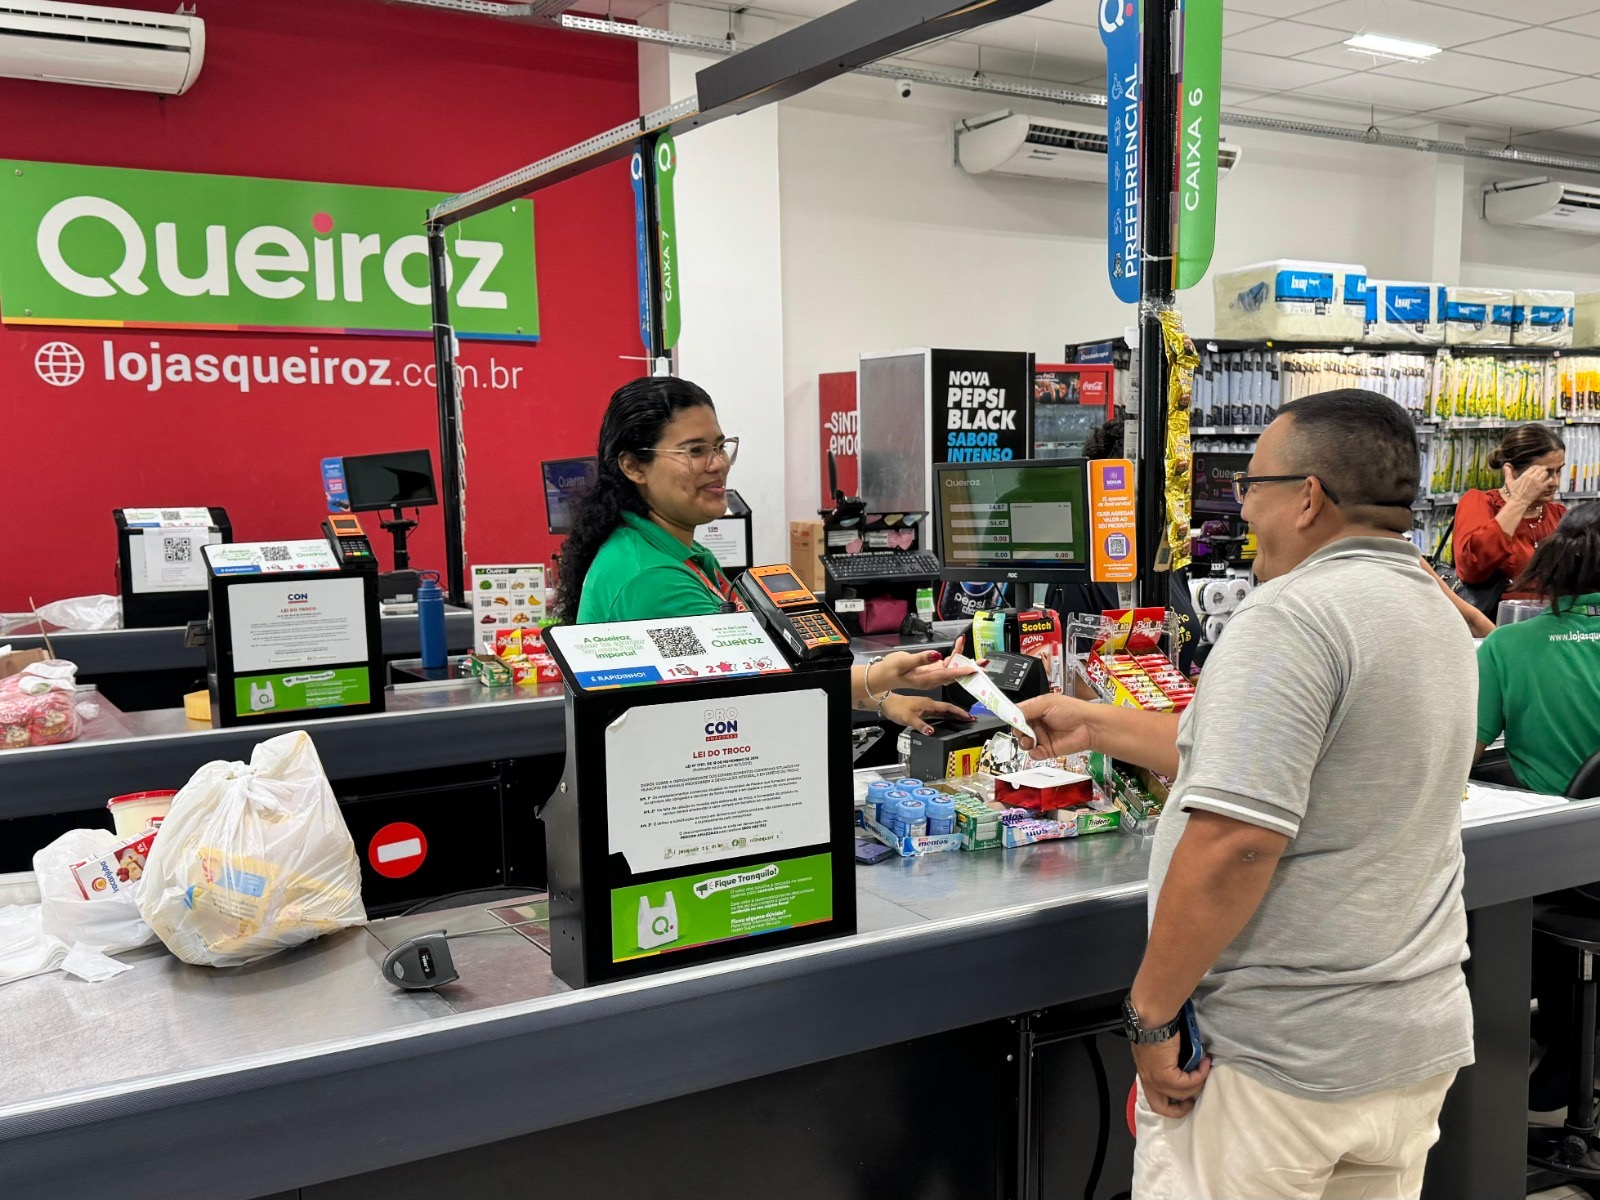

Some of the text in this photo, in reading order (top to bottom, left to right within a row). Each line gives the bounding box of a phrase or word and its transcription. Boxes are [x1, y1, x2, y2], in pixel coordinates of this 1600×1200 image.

[1185, 87, 1203, 212] CAIXA 6
[1124, 62, 1139, 278] PREFERENCIAL
[37, 195, 508, 310] Queiroz
[661, 230, 674, 302] CAIXA 7
[102, 340, 523, 392] lojasqueiroz.com.br
[948, 371, 990, 386] NOVA
[947, 388, 1006, 409] PEPSI
[824, 411, 858, 434] SiNT
[947, 409, 1017, 430] BLACK
[947, 432, 999, 447] SABOR
[947, 448, 1013, 463] INTENSO
[945, 478, 981, 488] Queiroz
[954, 592, 985, 609] pepsi
[1021, 621, 1052, 632] Scotch
[592, 634, 631, 642] Queiroz
[711, 637, 765, 648] Queiroz
[1021, 635, 1044, 646] BOND
[595, 650, 637, 659] importa!
[706, 665, 717, 673] 2
[743, 662, 753, 670] 3
[597, 671, 648, 681] RAPIDINHO!
[704, 706, 739, 723] PRO
[704, 719, 738, 735] CON
[693, 745, 751, 759] LEI DO TROCO
[1088, 818, 1111, 826] Trident
[918, 839, 949, 848] mentos
[714, 867, 777, 888] Fique Tranquilo!
